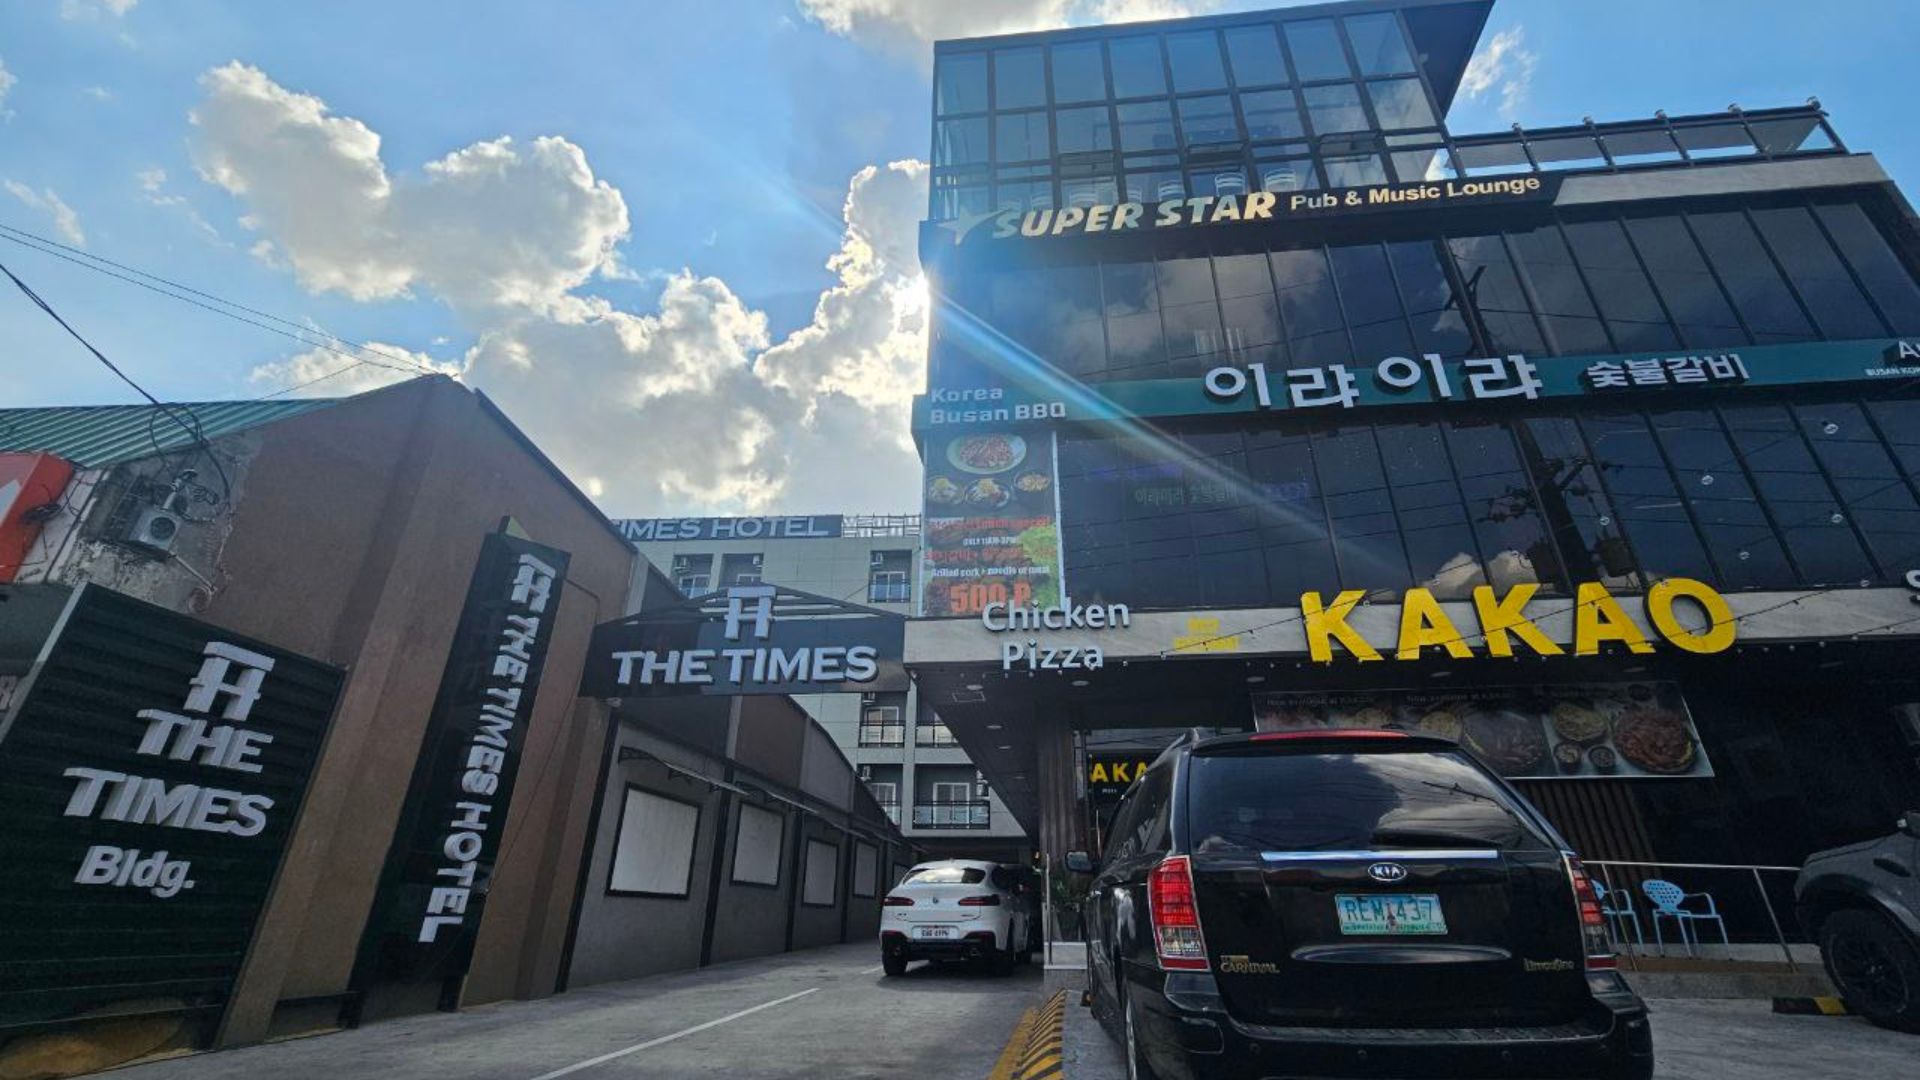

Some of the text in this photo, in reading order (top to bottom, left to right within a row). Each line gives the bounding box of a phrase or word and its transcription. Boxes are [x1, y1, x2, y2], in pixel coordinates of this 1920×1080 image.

[1290, 177, 1540, 210] Pub & Music Lounge
[992, 191, 1276, 239] SUPER STAR
[1587, 353, 1750, 388] 숯불갈비
[930, 386, 1003, 402] Korea
[930, 402, 1066, 424] Busan BBQ
[612, 515, 829, 539] IMES HOTEL
[950, 583, 1008, 613] 500
[982, 597, 1130, 631] Chicken
[1300, 577, 1737, 662] KAKAO
[612, 646, 878, 685] THE TIMES
[1002, 638, 1104, 671] Pizza
[137, 708, 273, 774] THE
[418, 614, 540, 942] THE TIMES HOTEL
[63, 767, 274, 837] TIMES
[74, 845, 195, 898] Bldg.
[1371, 865, 1402, 878] KIA
